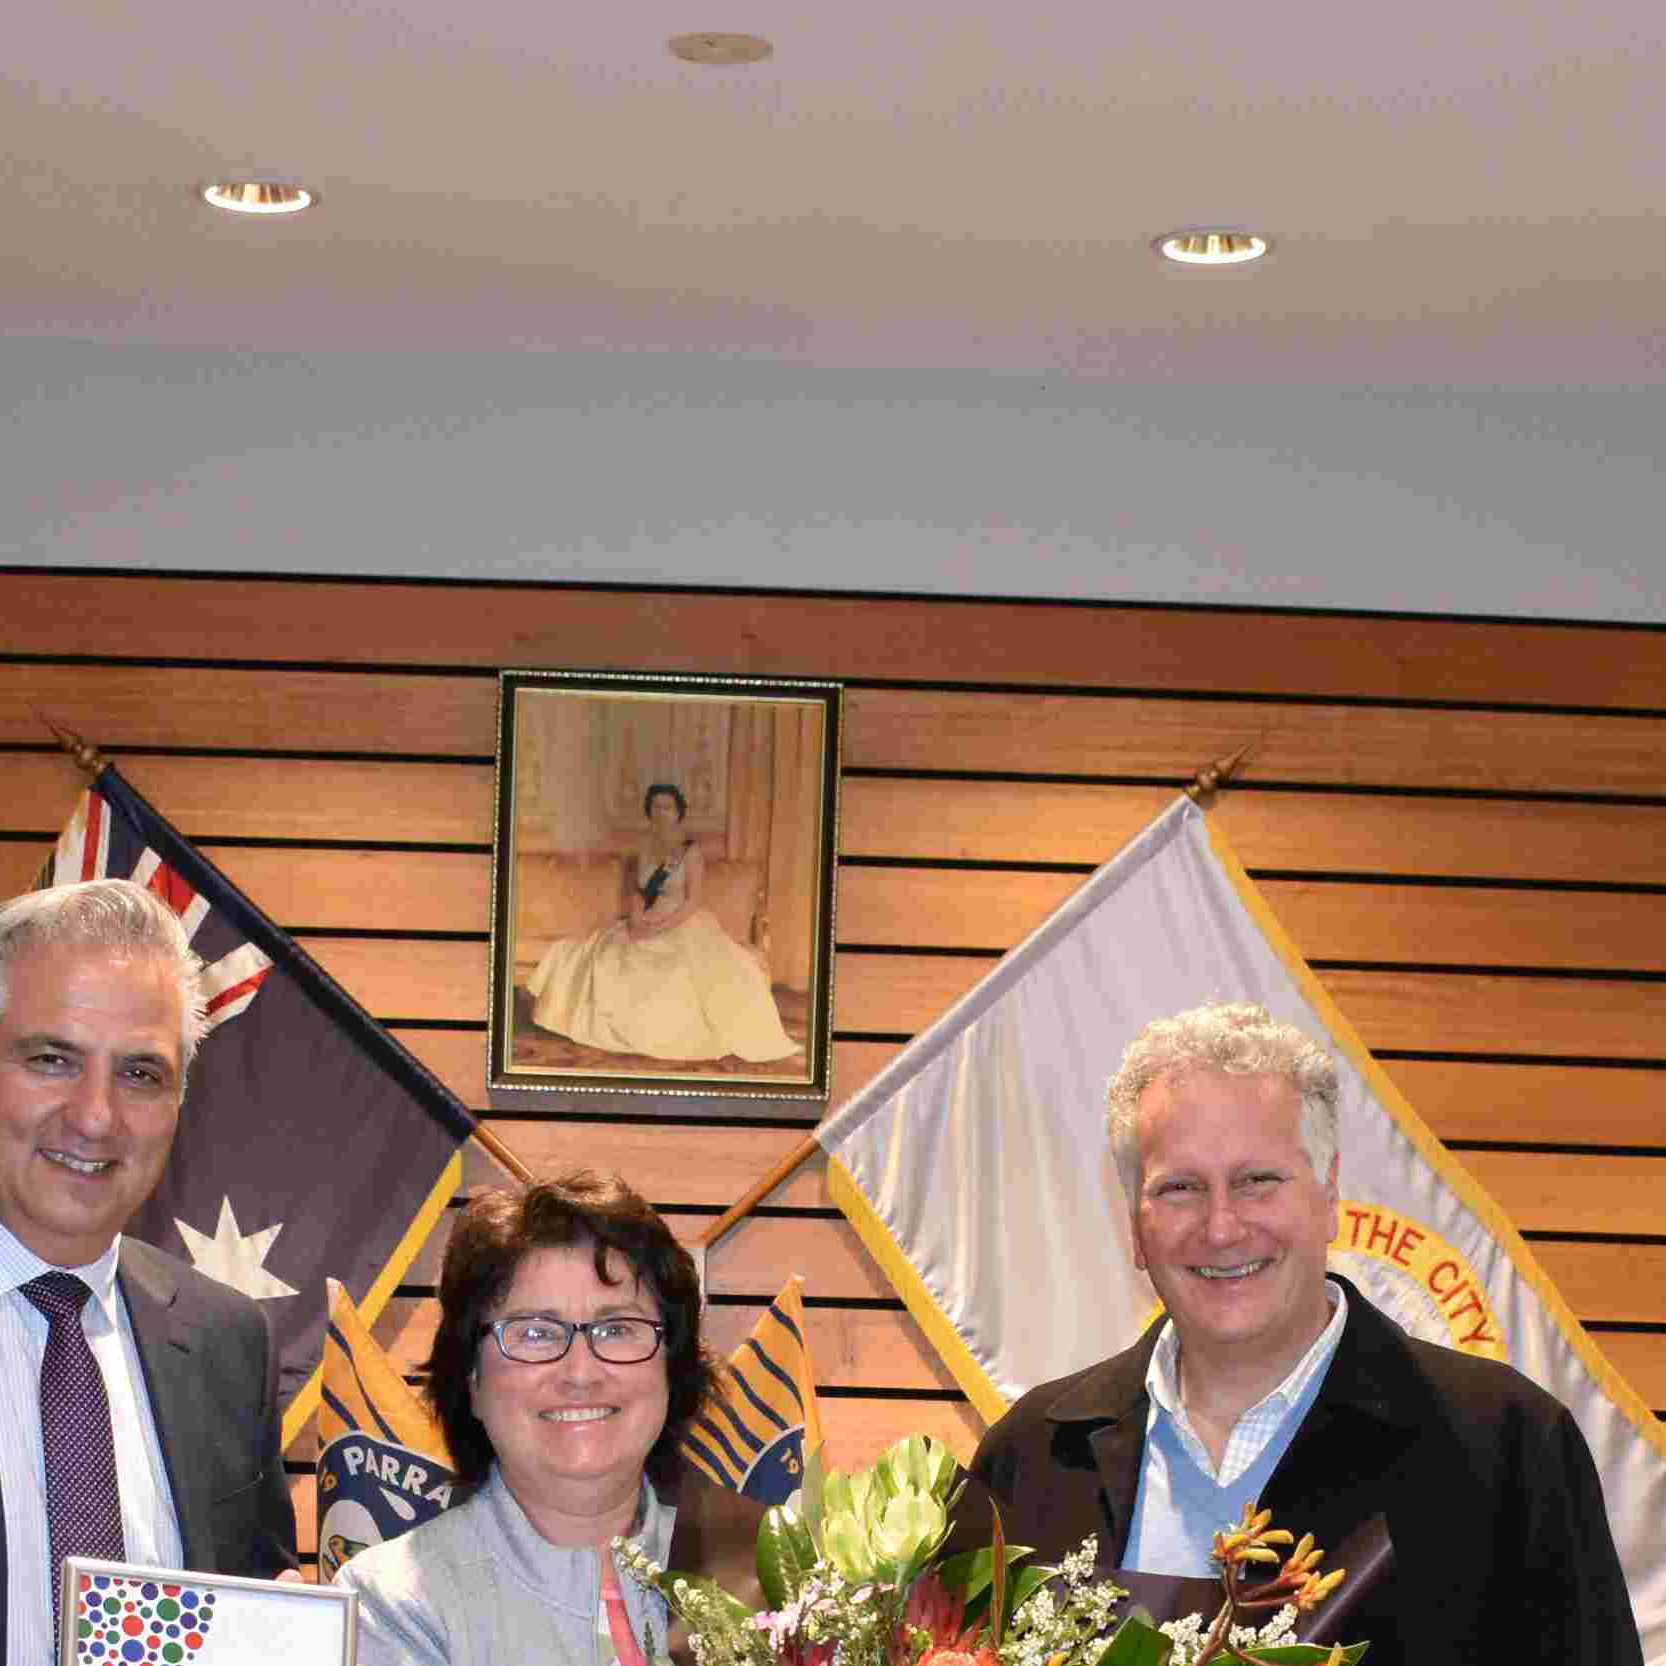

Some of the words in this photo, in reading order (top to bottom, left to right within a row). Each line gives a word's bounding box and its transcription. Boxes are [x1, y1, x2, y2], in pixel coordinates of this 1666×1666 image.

[1346, 1210, 1426, 1267] THE
[1428, 1260, 1496, 1344] CITY
[343, 1446, 453, 1509] PARRA
